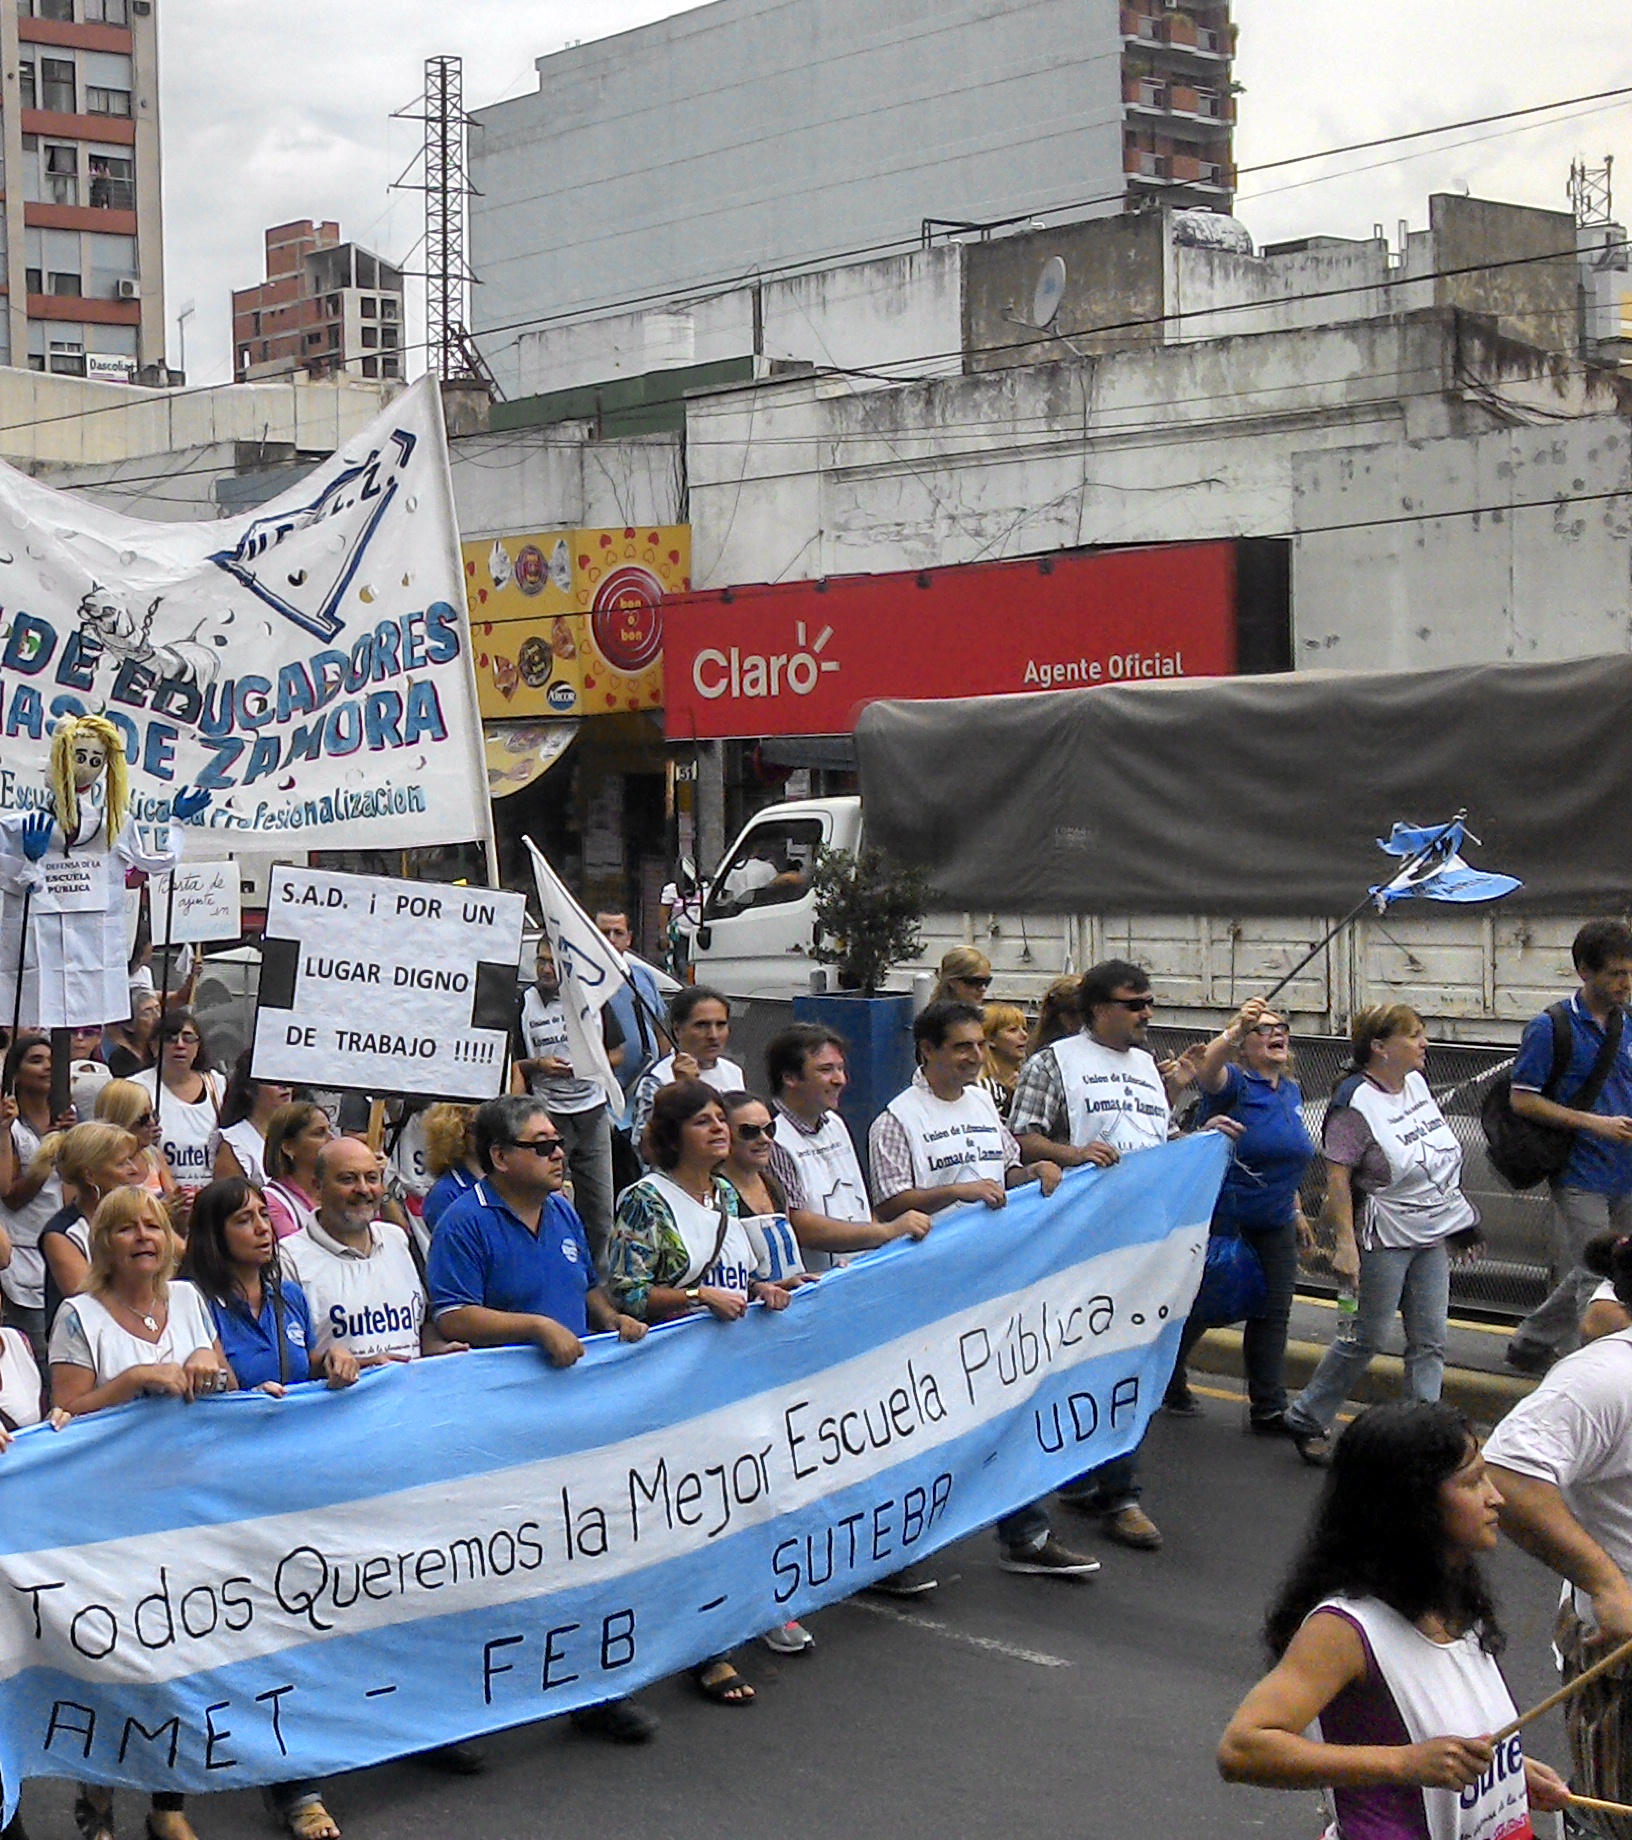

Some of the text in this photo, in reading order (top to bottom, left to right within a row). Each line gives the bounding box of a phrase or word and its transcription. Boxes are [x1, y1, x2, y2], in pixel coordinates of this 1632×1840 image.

[621, 629, 643, 641] bon
[2, 611, 105, 693] DE
[111, 601, 461, 737] EDUCADORES
[692, 645, 1185, 699] Claro Agente Oficial
[193, 680, 449, 790] ZAMORA
[45, 861, 79, 871] DEFENSA
[45, 873, 91, 883] ESCUELA
[210, 872, 226, 889] de
[177, 893, 217, 917] ajuste
[281, 882, 349, 910] S.A.D.
[396, 895, 443, 920] POR
[462, 902, 496, 926] UN
[305, 957, 470, 994] LUGAR DIGNO
[285, 1024, 495, 1064] DE TRABAJO !!!!!
[1082, 1073, 1110, 1085] Union
[1124, 1086, 1133, 1096] de
[1085, 1098, 1120, 1114] Lomas
[1121, 1100, 1133, 1112] de
[923, 1130, 950, 1144] Union
[950, 1125, 960, 1136] de
[966, 1137, 975, 1147] de
[927, 1153, 964, 1172] Lomas
[965, 1152, 976, 1163] de
[329, 1302, 413, 1338] Suteba
[9, 1565, 253, 1660] Todos
[274, 1520, 544, 1631] Queremos
[561, 1486, 609, 1560] la
[629, 1444, 774, 1542] Mejor
[784, 1359, 948, 1480] Escuela
[43, 1685, 294, 1770] AMET
[483, 1608, 636, 1705] FEB
[771, 1472, 953, 1605] SUTEBA
